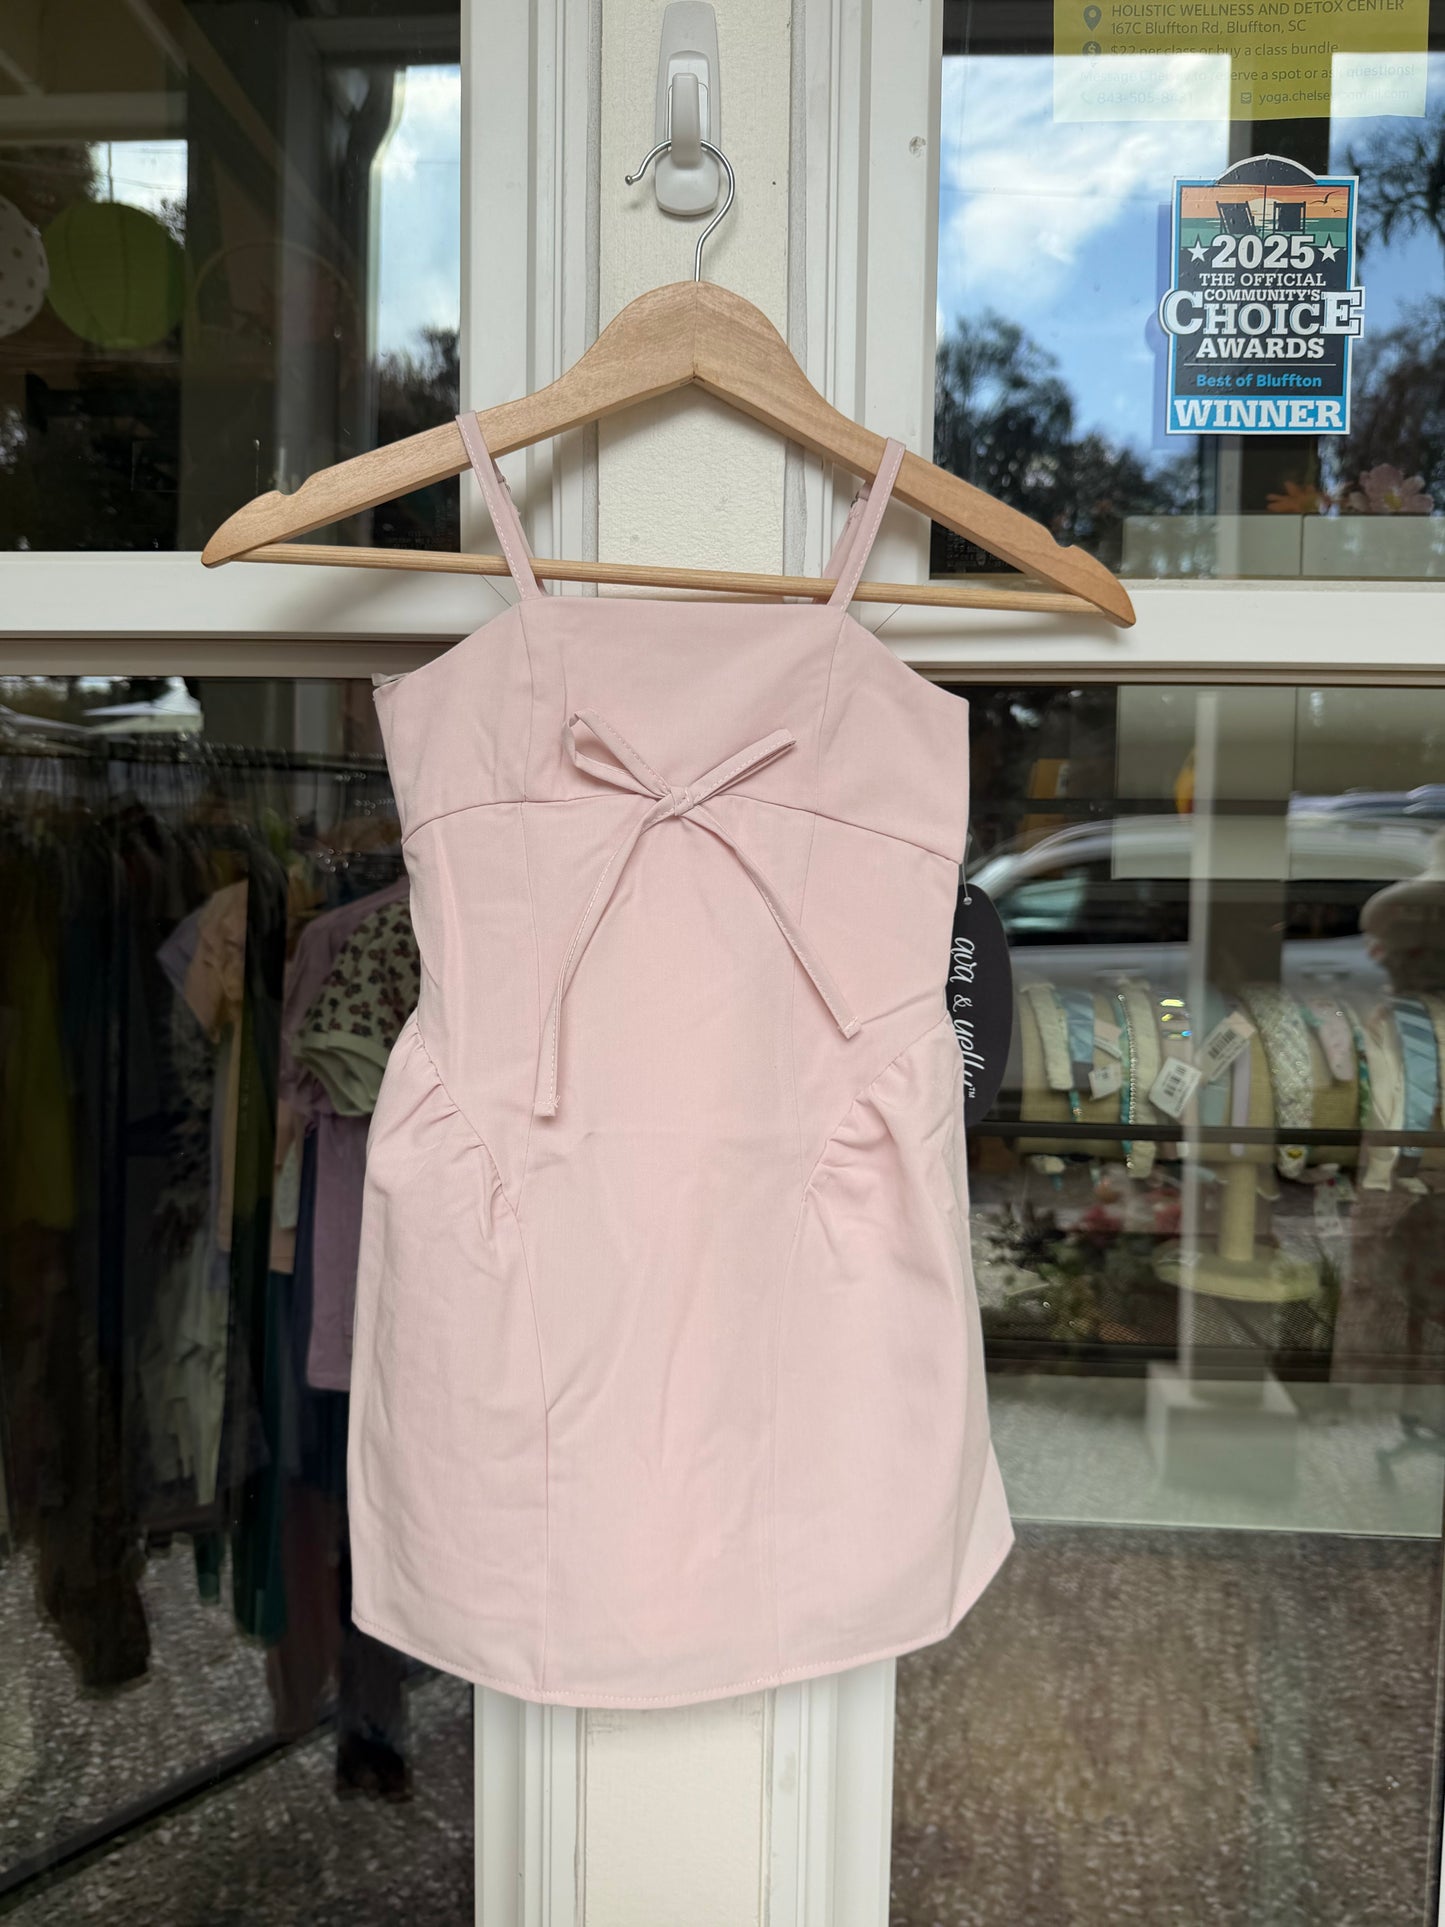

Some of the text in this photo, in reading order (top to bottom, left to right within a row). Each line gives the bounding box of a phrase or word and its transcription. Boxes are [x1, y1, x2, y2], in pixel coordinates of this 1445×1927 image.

[1112, 0, 1404, 17] HOLISTIC WELLNESS AND DETOX CENTER
[1112, 19, 1307, 35] 167C Bluffton Rd, Bluffton, SC
[1217, 44, 1242, 58] buy
[1244, 47, 1251, 56] a
[1255, 43, 1288, 56] class
[1291, 41, 1339, 55] bundle
[1261, 71, 1269, 80] a
[1271, 69, 1302, 82] spot
[1304, 70, 1319, 80] or
[1211, 234, 1315, 269] 2025
[1199, 272, 1326, 287] THE OFFICIAL
[1204, 288, 1321, 302] COMMUNITY'S
[1163, 290, 1362, 336] CHOICE
[1196, 337, 1325, 359] AWARDS
[1196, 374, 1322, 388] Best of Bluffton
[1174, 399, 1343, 428] WINNER
[952, 994, 973, 1012] &
